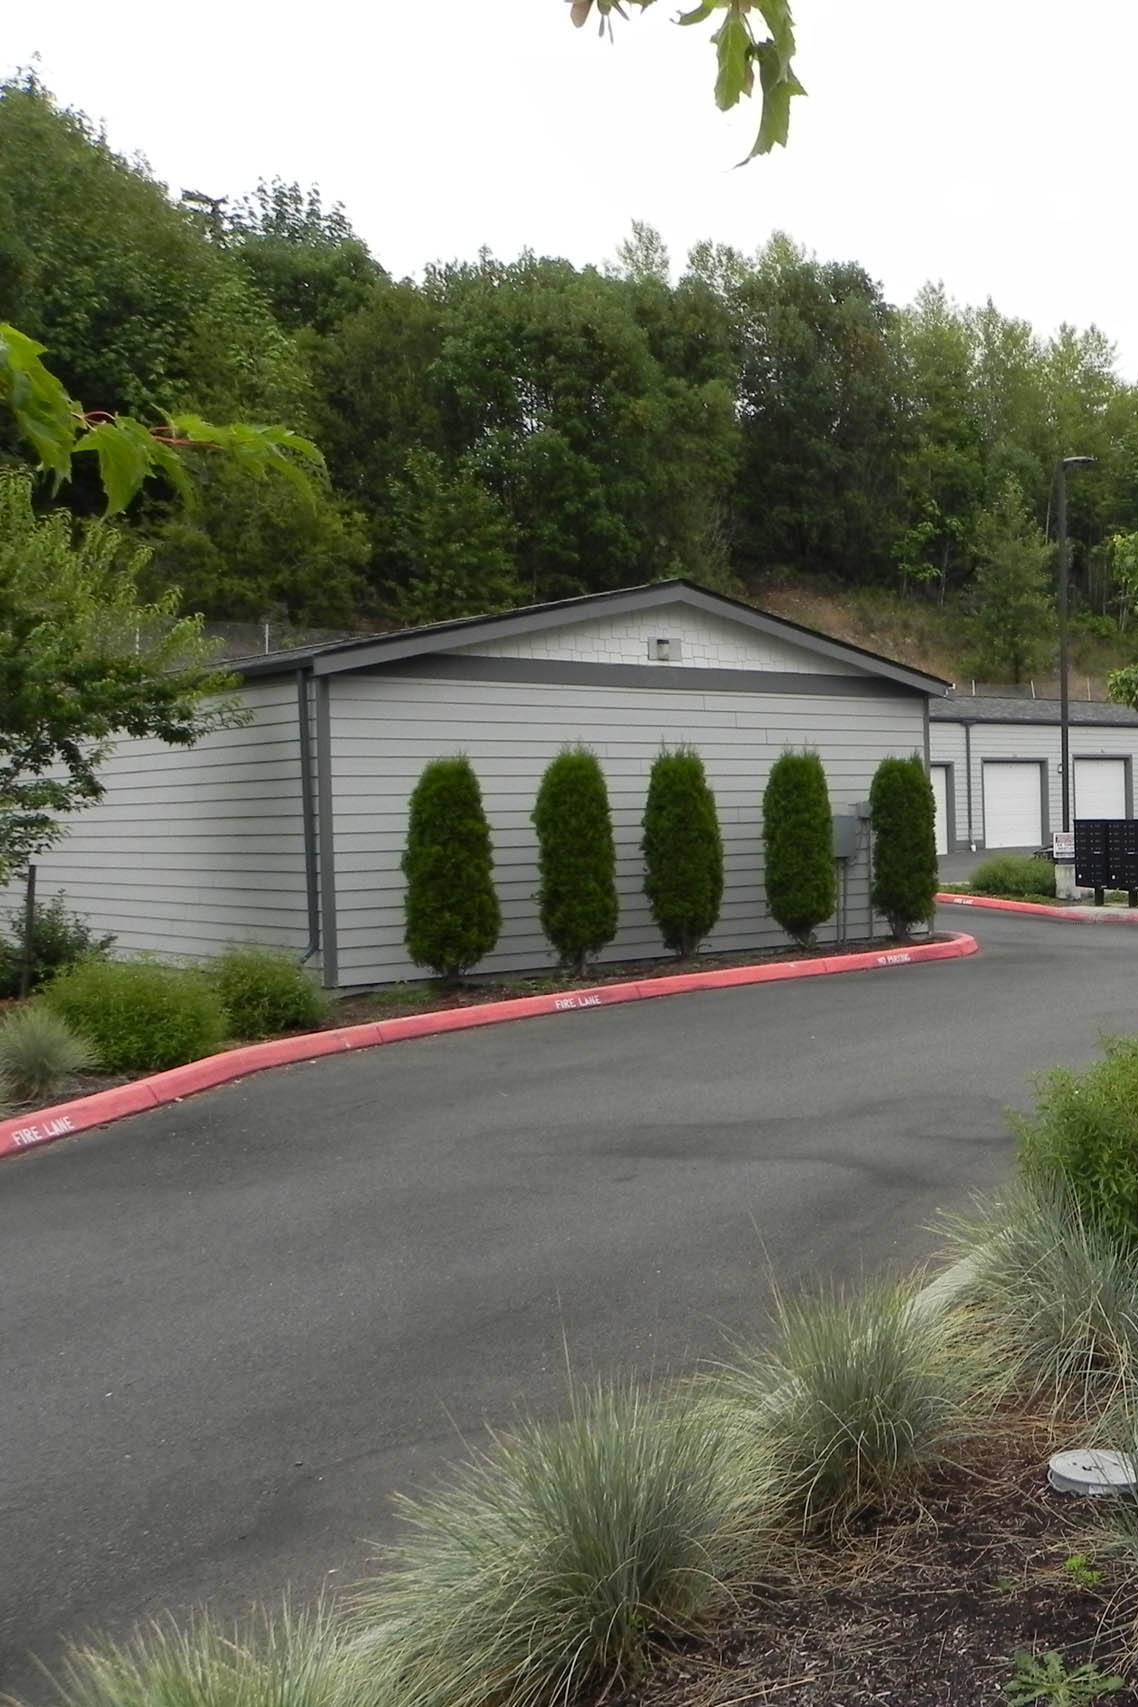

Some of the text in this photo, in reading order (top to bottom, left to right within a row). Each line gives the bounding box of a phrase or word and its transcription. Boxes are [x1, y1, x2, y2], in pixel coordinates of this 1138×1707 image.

[554, 994, 601, 1009] FIRE LANE
[11, 1116, 74, 1146] FIRE LANE
